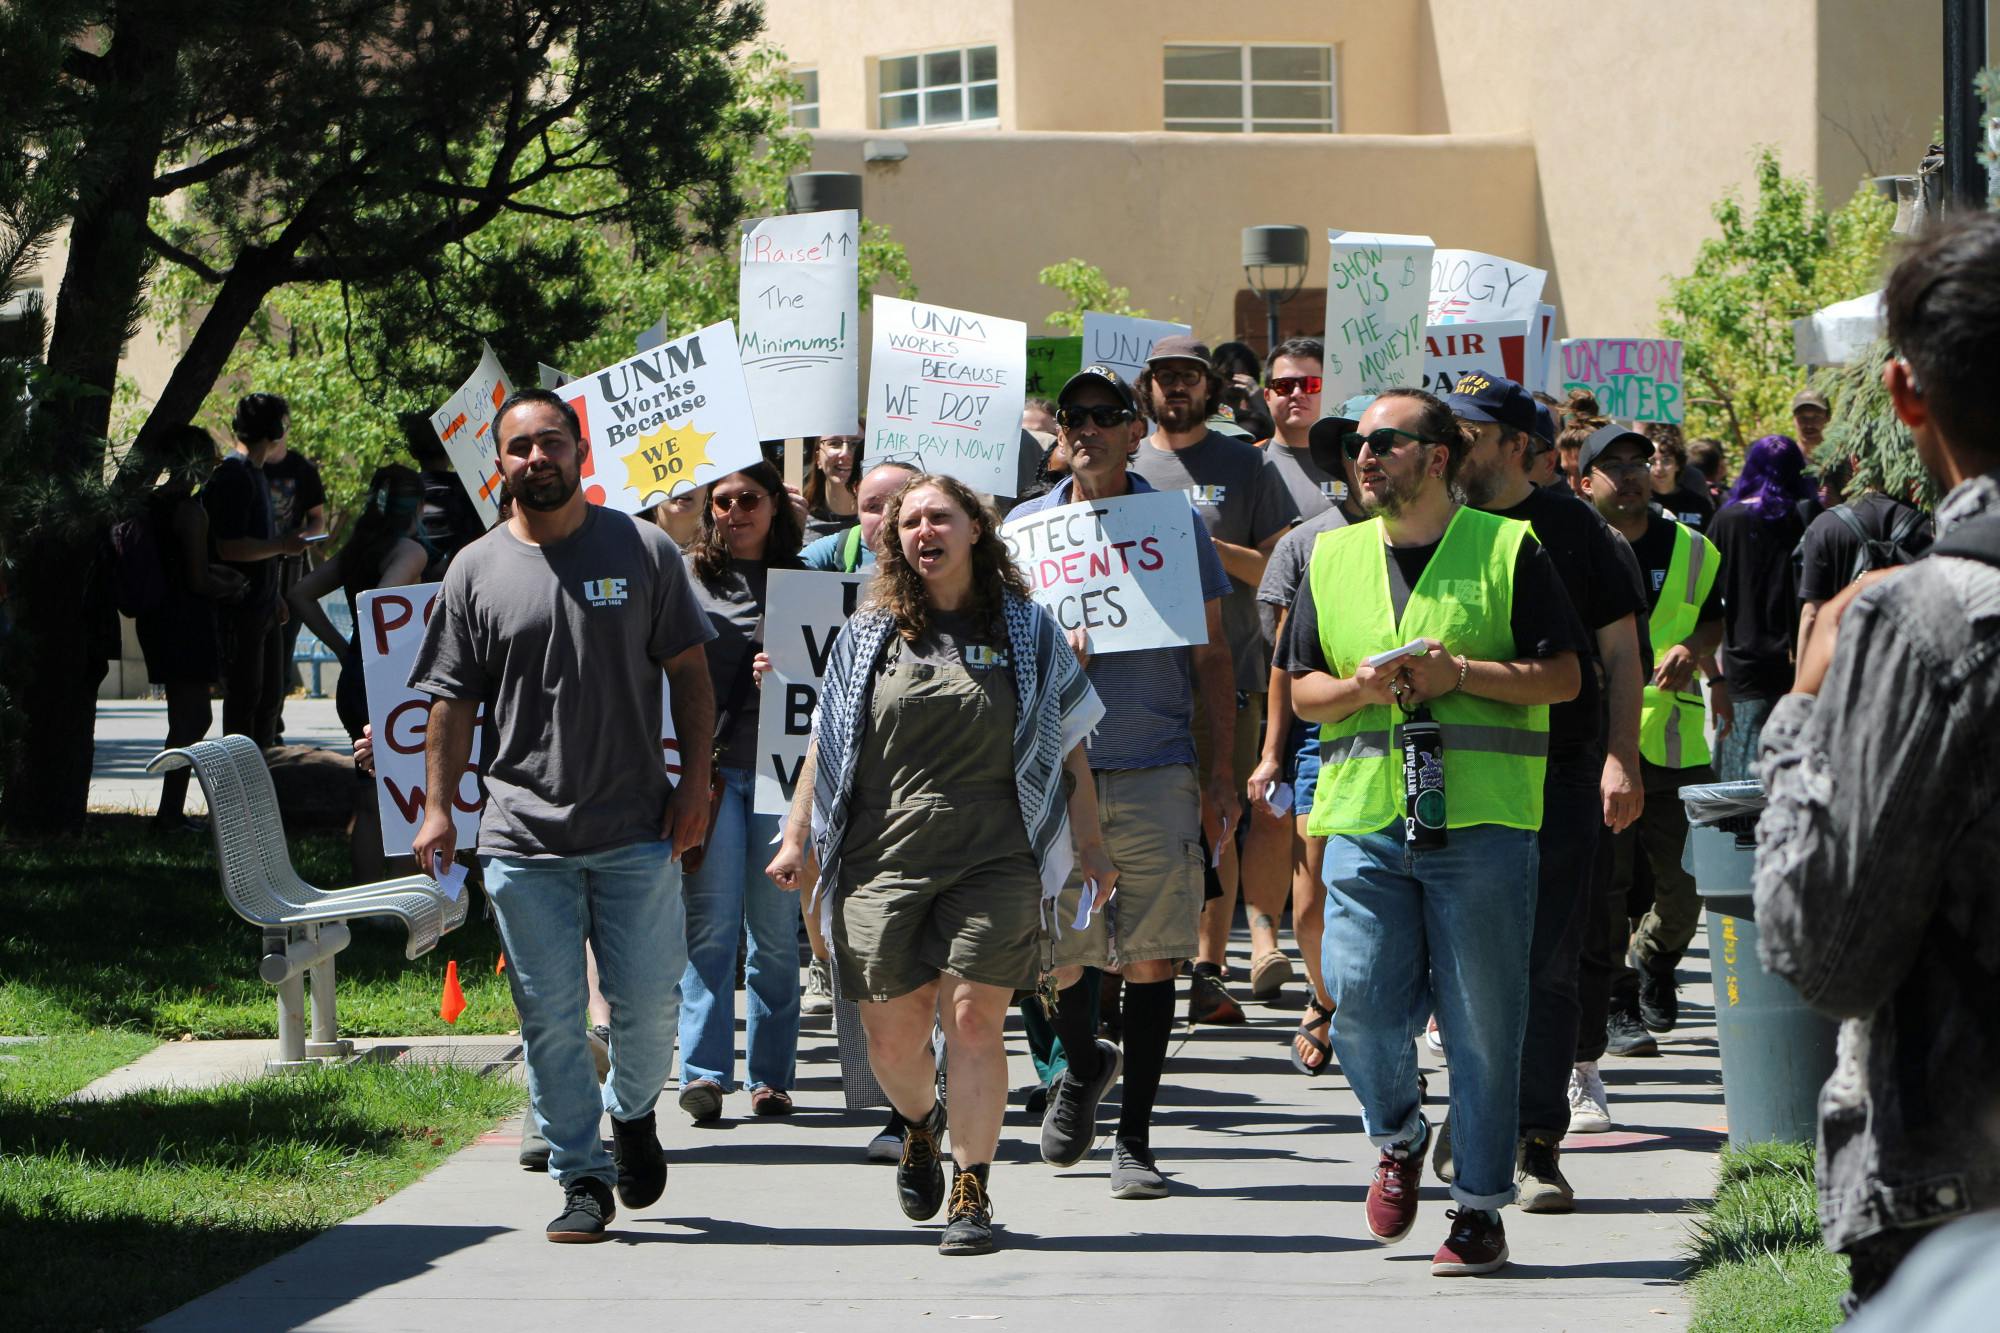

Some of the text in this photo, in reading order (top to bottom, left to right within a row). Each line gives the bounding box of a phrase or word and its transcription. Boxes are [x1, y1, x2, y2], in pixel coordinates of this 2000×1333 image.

[755, 234, 822, 264] Raise
[1333, 236, 1382, 290] SHOW
[758, 285, 805, 311] The
[1357, 271, 1389, 306] US
[740, 311, 846, 357] Minimums!
[911, 306, 987, 338] UNM
[1341, 313, 1383, 346] THE
[888, 332, 960, 355] WORKS
[1027, 346, 1055, 364] ery
[1358, 313, 1419, 383] MONEY!
[1424, 333, 1486, 358] AIR
[597, 335, 707, 404] UNM
[921, 358, 1009, 386] BECAUSE
[1562, 339, 1683, 384] UNION
[1026, 370, 1048, 393] at
[611, 379, 696, 423] Works
[885, 383, 990, 427] WE DO!
[606, 394, 706, 448] Because
[641, 437, 680, 465] WE
[876, 428, 1006, 474] FAIR PAY NOW!
[652, 457, 684, 483] DO
[1193, 485, 1226, 501] UE
[584, 578, 628, 601] UE
[1046, 585, 1128, 631] CES
[1405, 744, 1418, 796] INTIFADA
